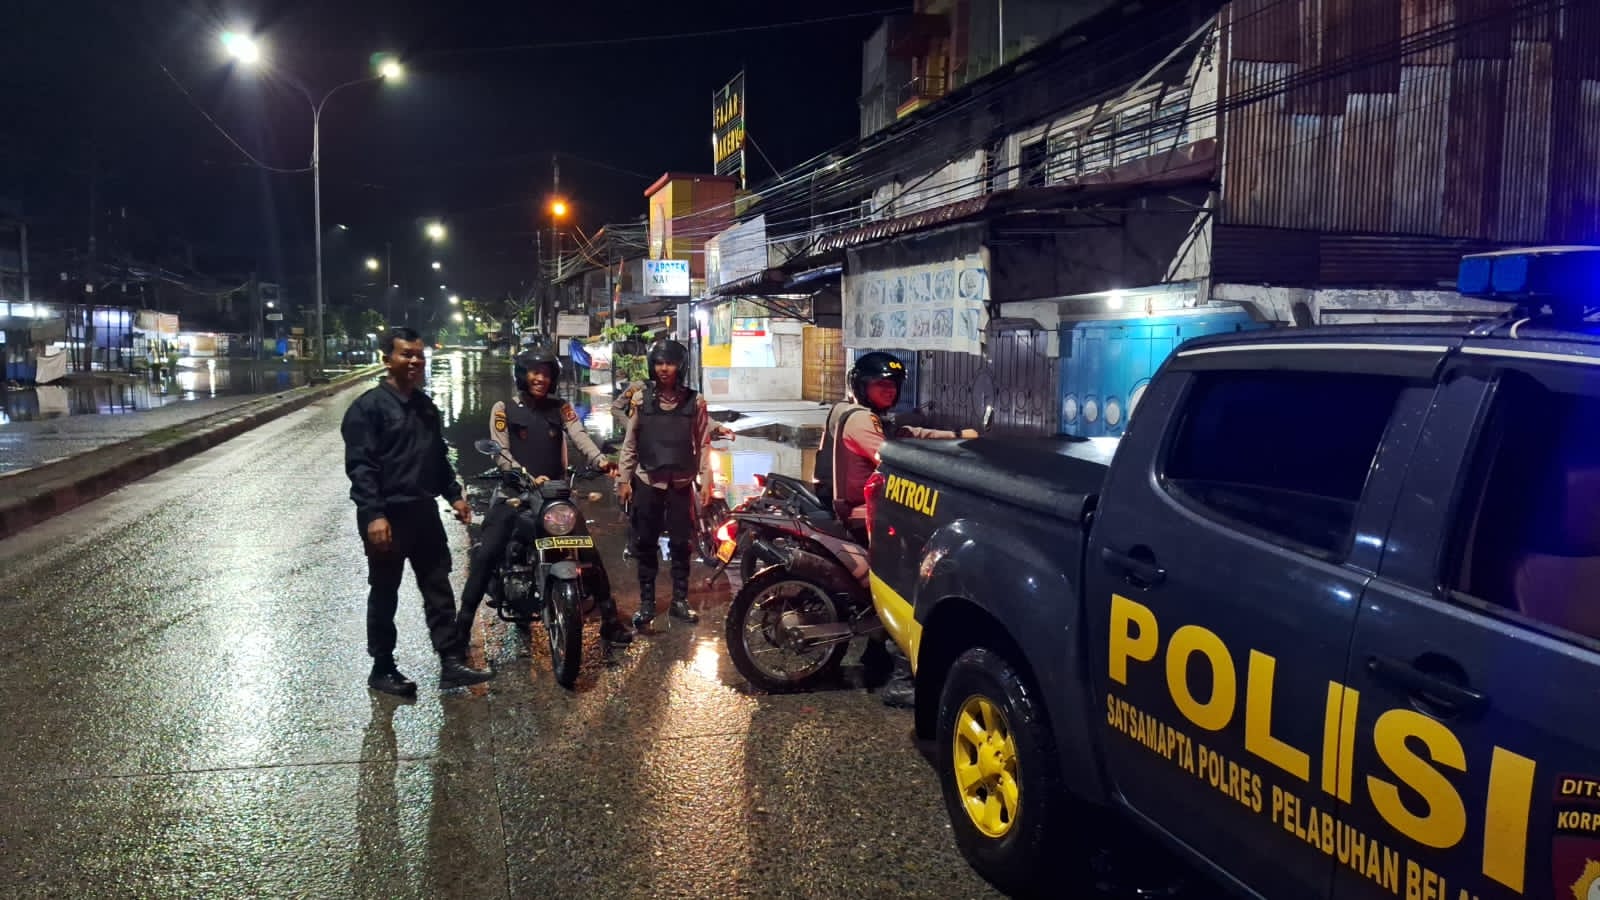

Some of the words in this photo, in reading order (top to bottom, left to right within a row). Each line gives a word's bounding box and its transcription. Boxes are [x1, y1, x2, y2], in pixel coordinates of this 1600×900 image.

[716, 93, 738, 129] FAJAR
[655, 262, 686, 272] APOTEK
[885, 474, 938, 517] PATROLI
[1109, 593, 1536, 895] POLISI
[1107, 693, 1195, 774] SATSAMAPTA
[1199, 744, 1263, 814] POLRES
[1272, 785, 1399, 895] PELABUHAN
